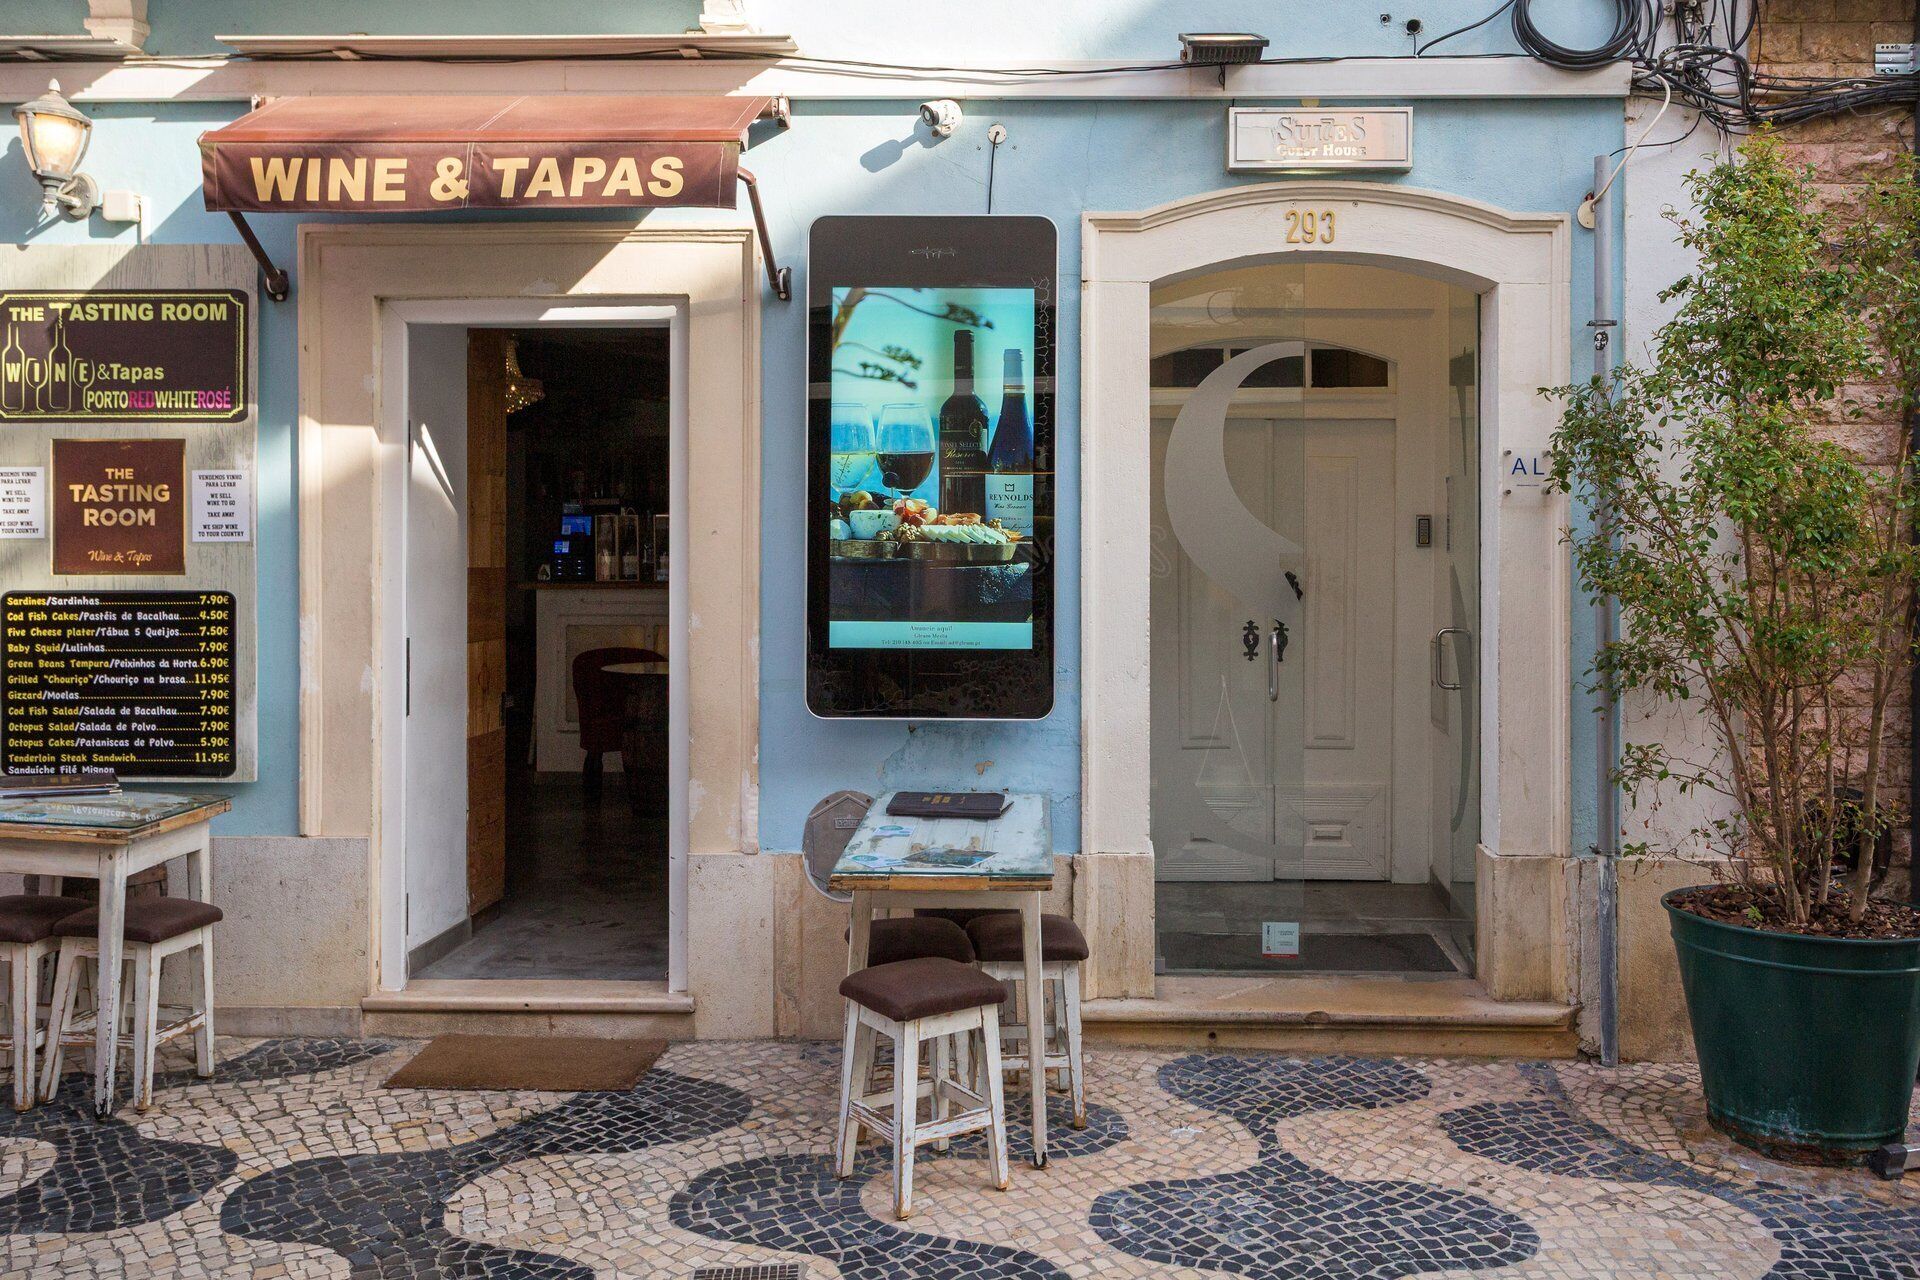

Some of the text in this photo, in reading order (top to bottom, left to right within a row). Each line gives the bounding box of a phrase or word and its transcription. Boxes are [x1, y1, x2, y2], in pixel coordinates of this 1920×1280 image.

[250, 155, 686, 202] WINE & TAPAS
[1285, 209, 1336, 243] 293
[9, 302, 228, 323] THE TASTING ROOM
[105, 468, 134, 480] THE
[69, 484, 170, 503] TASTING
[989, 493, 1033, 501] REYNOLDS
[84, 508, 156, 527] ROOM
[88, 550, 152, 566] Wine & Tapas
[7, 610, 229, 621] Cod Fish Cakes/Pastéis de Bacalhau 4.50€
[7, 627, 26, 636] Five
[30, 627, 62, 636] Cheese
[134, 627, 141, 636] 5
[145, 627, 180, 638] Queijos
[199, 626, 229, 636] 7.50€
[7, 642, 229, 654] Baby Squid/Lulinhas 7.90€
[7, 659, 33, 668] Green
[38, 659, 65, 668] Beans
[159, 659, 170, 668] da
[199, 658, 230, 668] 6.90€
[7, 674, 38, 684] Grilled
[143, 676, 155, 684] na
[159, 674, 186, 684] brasa
[195, 673, 230, 684] 11.95€
[8, 690, 230, 700] Gizzard/Moelas 7.90€
[8, 705, 230, 716] Cod Fish Salad/Salada de Bacalhau 7.90€
[8, 721, 230, 733] Octopus Salad/Salada de Polvo 7.90€
[8, 737, 230, 749] Octopus Cakes/Pataniscas de Polvo 5.90€
[8, 752, 230, 763] Tenderloin Steak Sandwich 11.95€
[8, 765, 55, 774] Sanduíche
[60, 765, 77, 774] Filé
